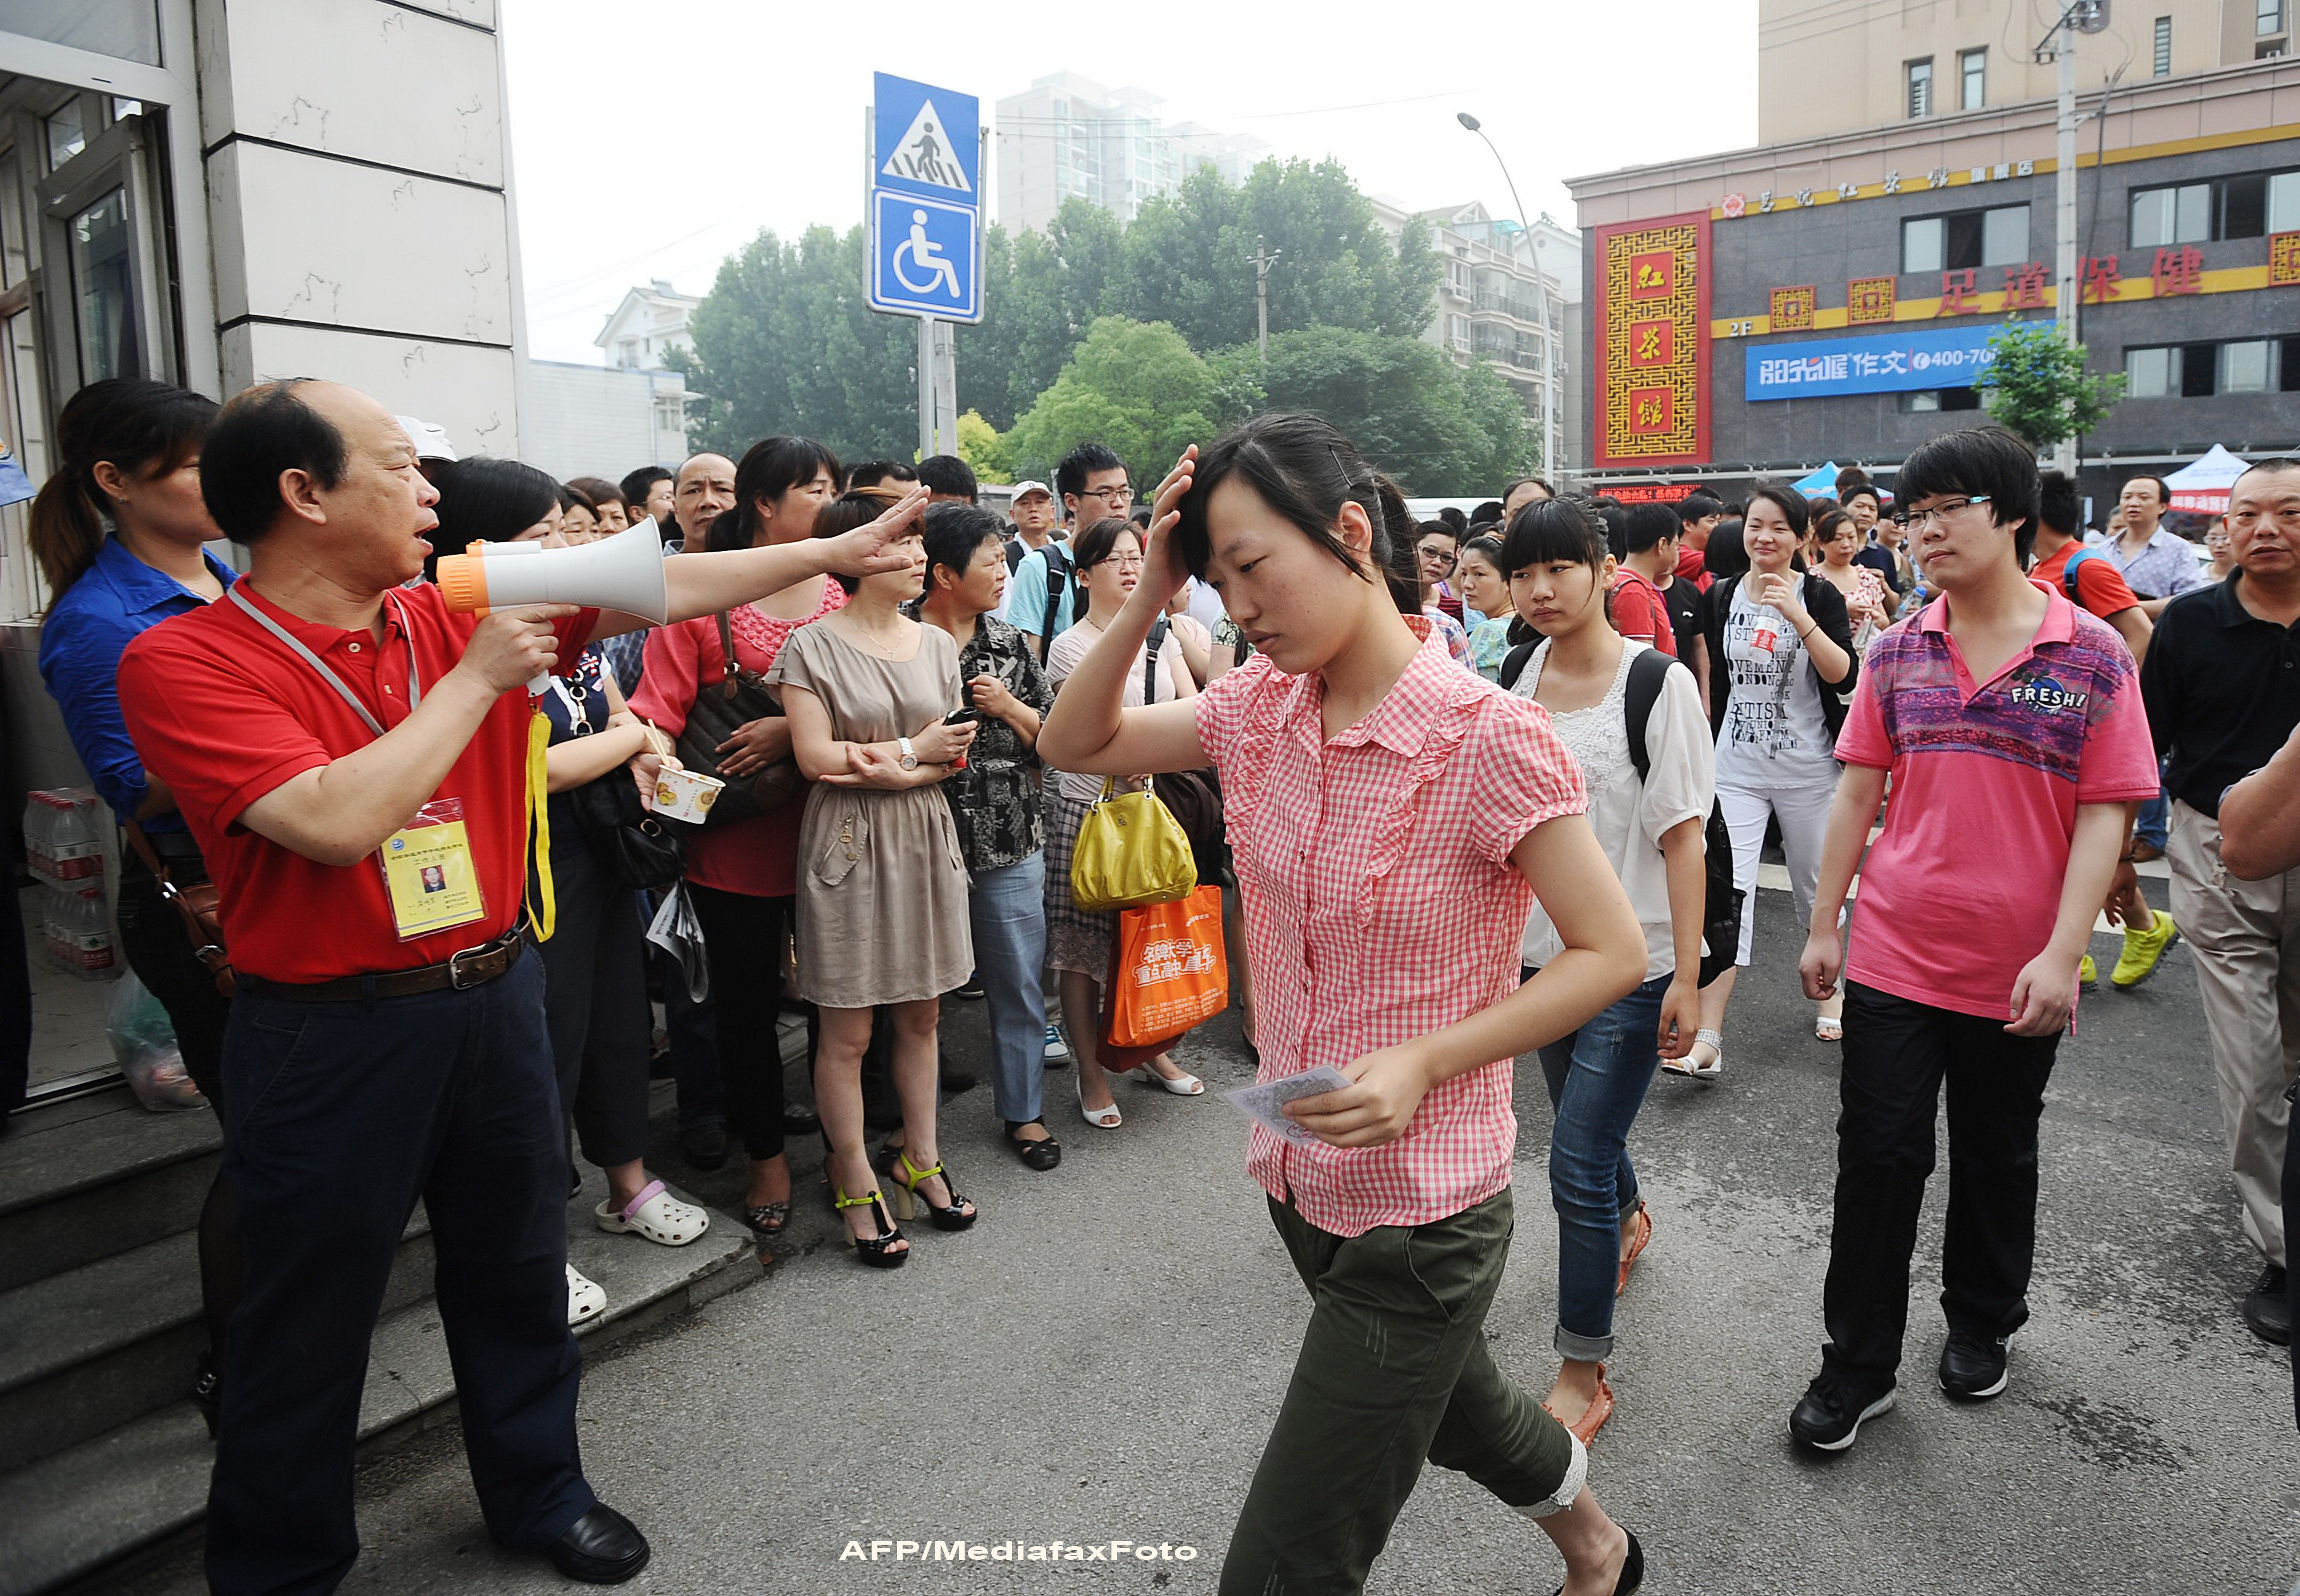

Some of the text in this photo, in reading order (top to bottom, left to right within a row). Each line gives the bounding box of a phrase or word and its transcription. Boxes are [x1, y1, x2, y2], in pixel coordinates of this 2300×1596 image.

[1935, 245, 2204, 317] 足道保健
[1729, 321, 1752, 338] 2F
[2012, 687, 2087, 708] FRESH!
